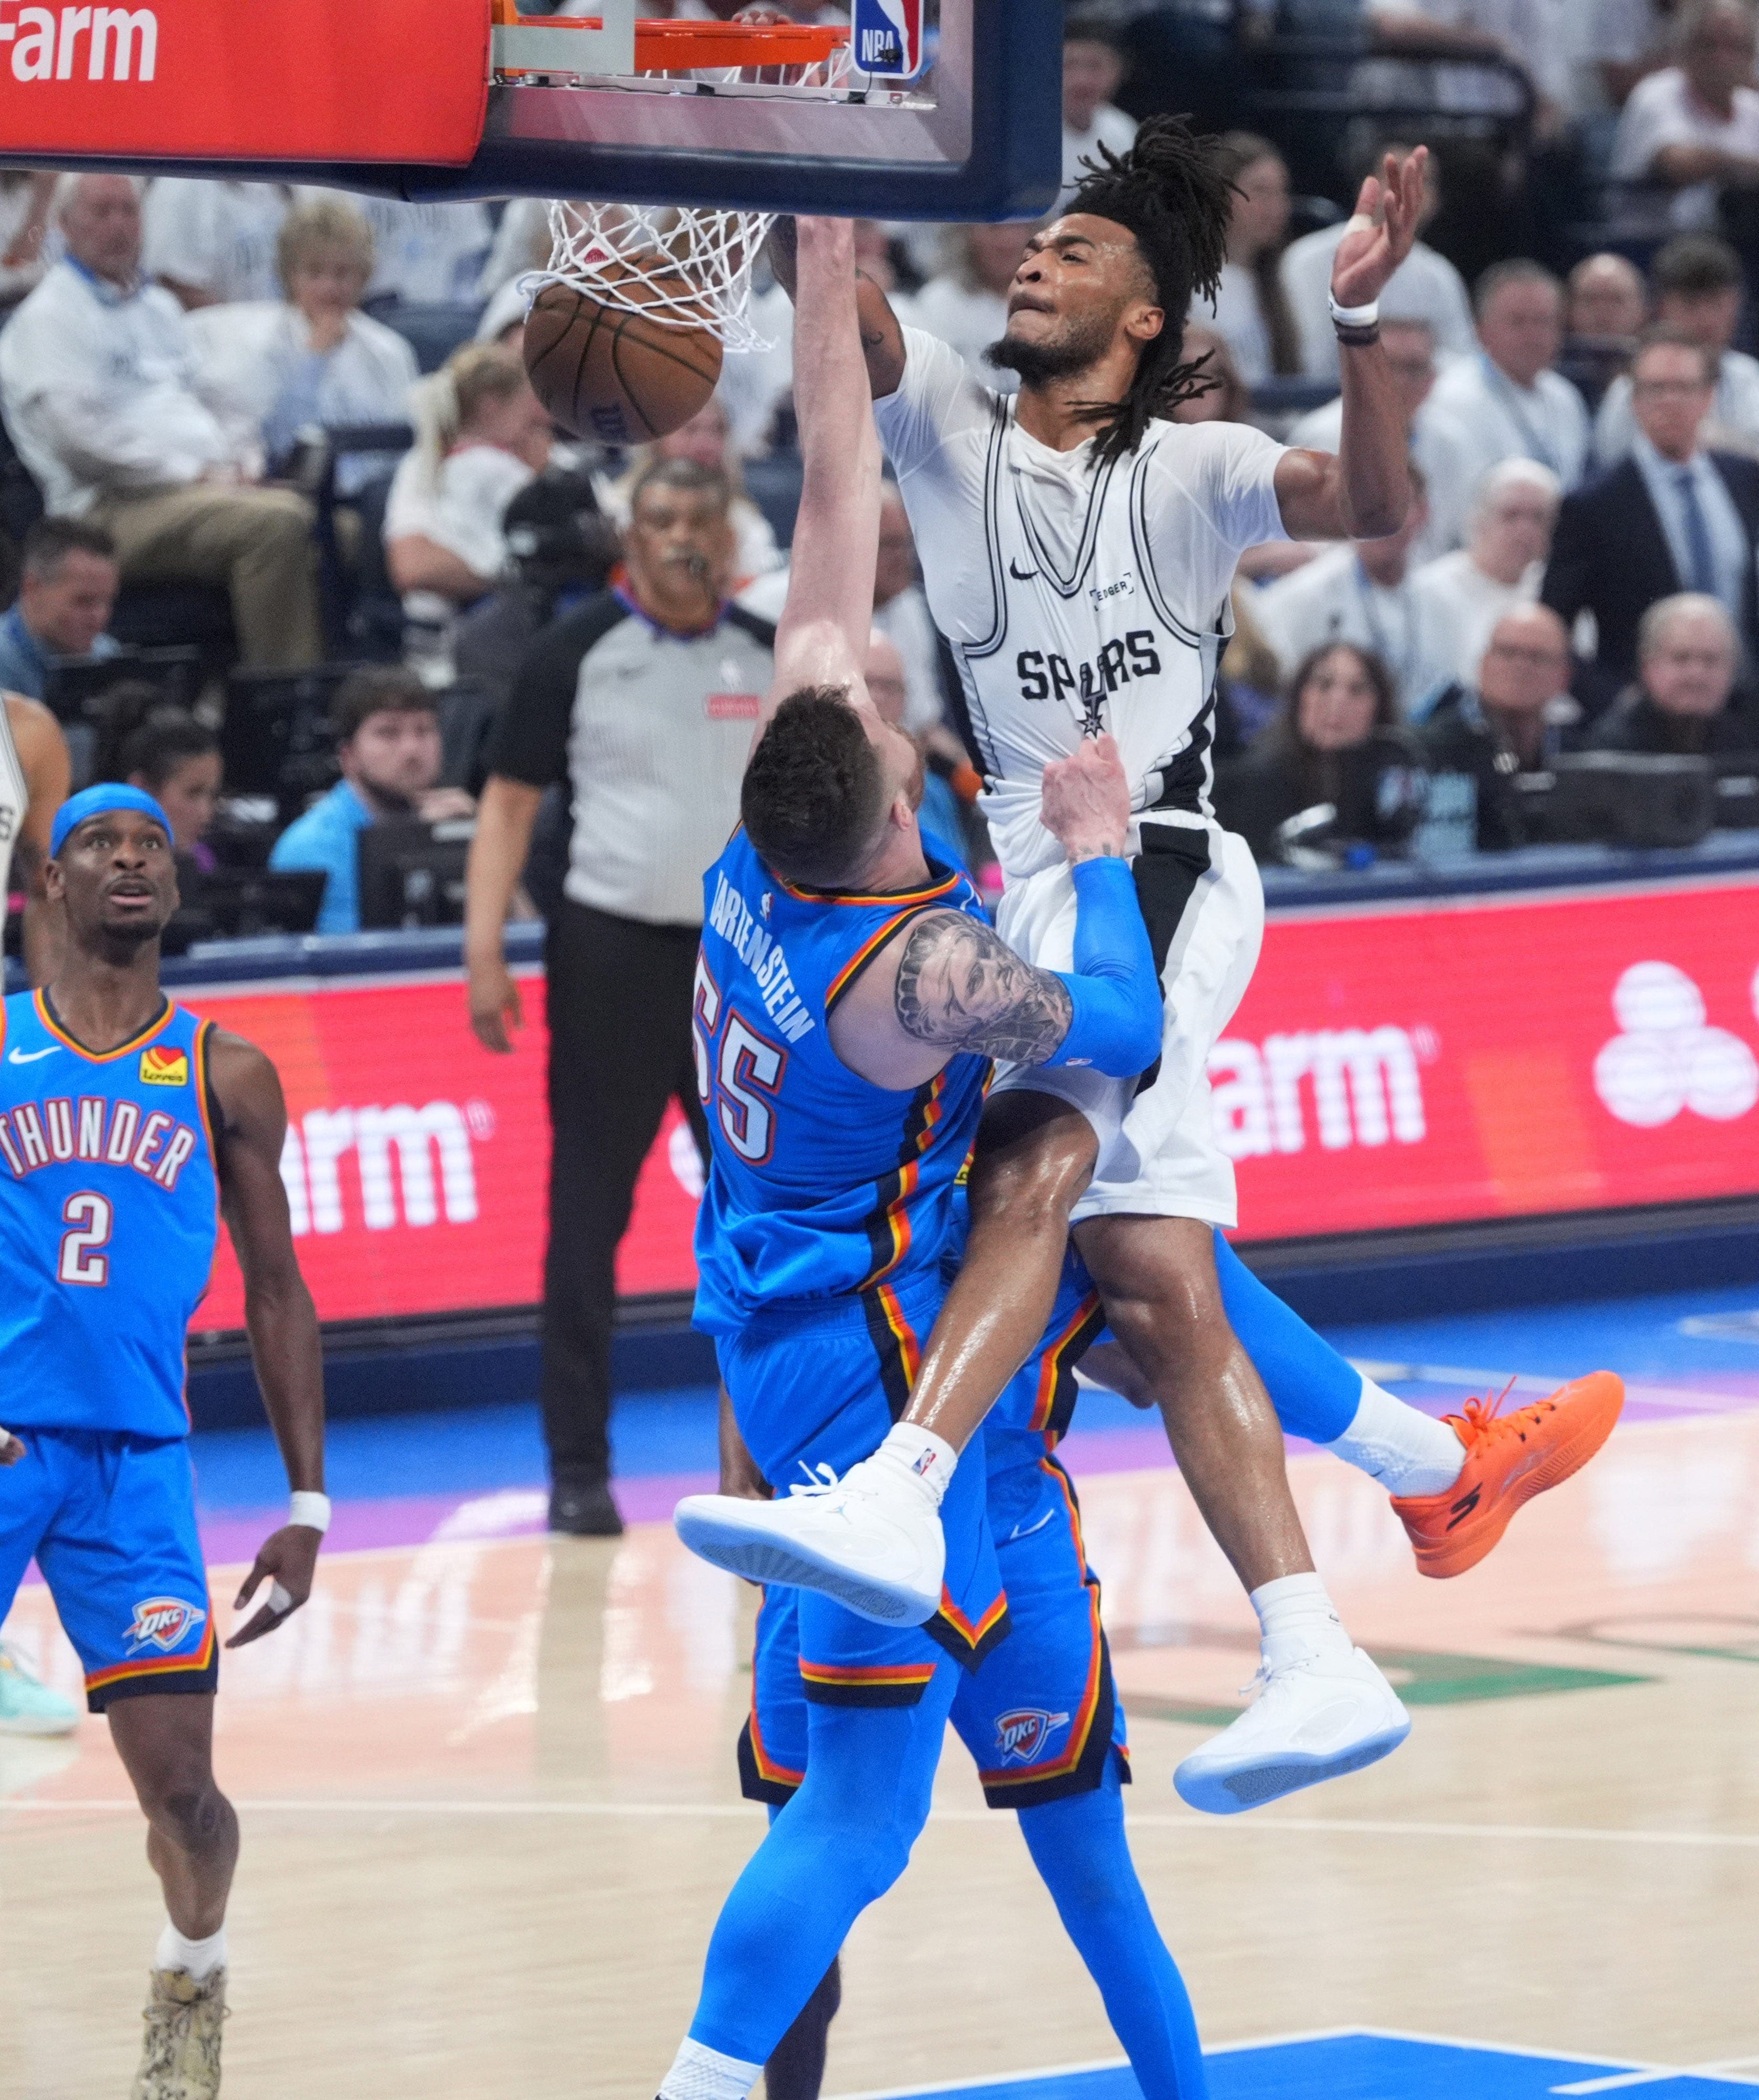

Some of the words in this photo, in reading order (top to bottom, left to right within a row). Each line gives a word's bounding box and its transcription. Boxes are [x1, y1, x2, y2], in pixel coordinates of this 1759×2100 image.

[862, 29, 894, 62] NBA
[1096, 581, 1127, 601] EDGER
[1017, 630, 1161, 707] SPURS
[0, 1096, 196, 1190] THUNDER
[58, 1191, 112, 1286] 2
[139, 1608, 182, 1639] OKC
[1004, 1718, 1036, 1752] OKC
